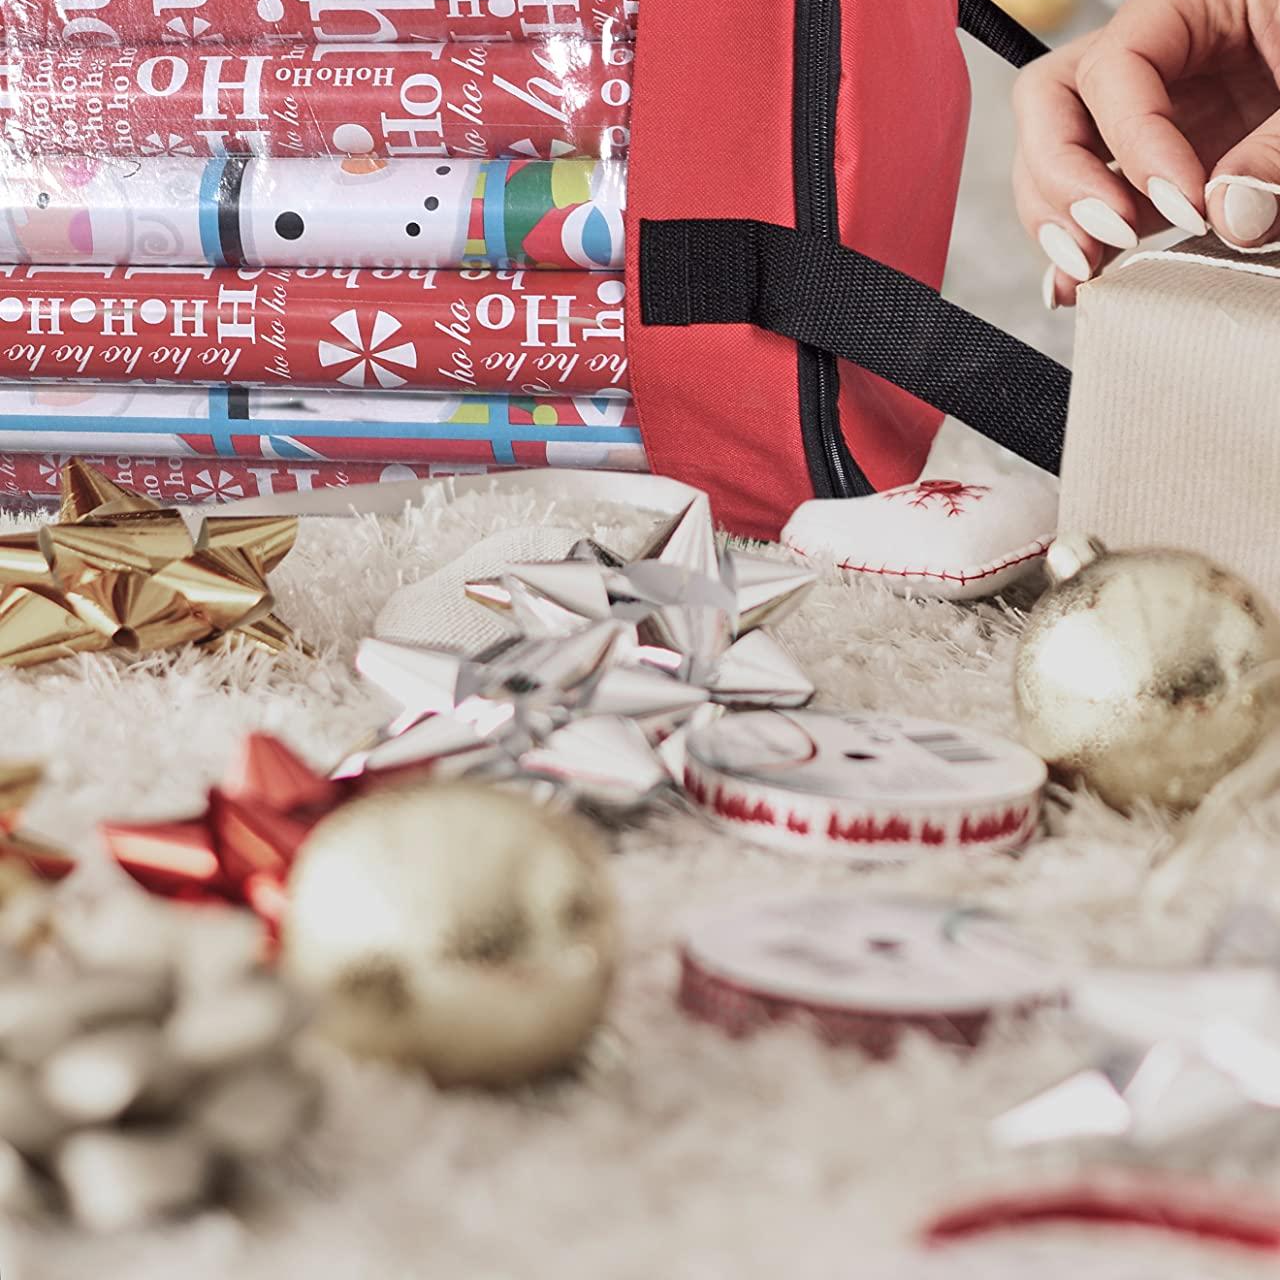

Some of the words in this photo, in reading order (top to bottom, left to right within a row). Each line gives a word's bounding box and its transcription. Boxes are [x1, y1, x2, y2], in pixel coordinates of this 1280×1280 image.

[450, 45, 488, 77] ho
[107, 75, 131, 111] ho
[275, 67, 395, 88] HoHoHo
[273, 93, 300, 126] ho
[380, 73, 450, 157] Ho
[447, 80, 484, 125] ho
[261, 284, 288, 315] ho
[260, 319, 287, 351] ho
[434, 297, 471, 346] ho
[475, 293, 577, 348] Ho
[3, 343, 46, 372] ho
[51, 344, 94, 373] ho
[99, 345, 143, 375] ho
[149, 346, 193, 375] ho
[197, 347, 242, 376] ho
[438, 347, 477, 385] ho
[480, 351, 526, 382] ho
[532, 352, 580, 382] ho
